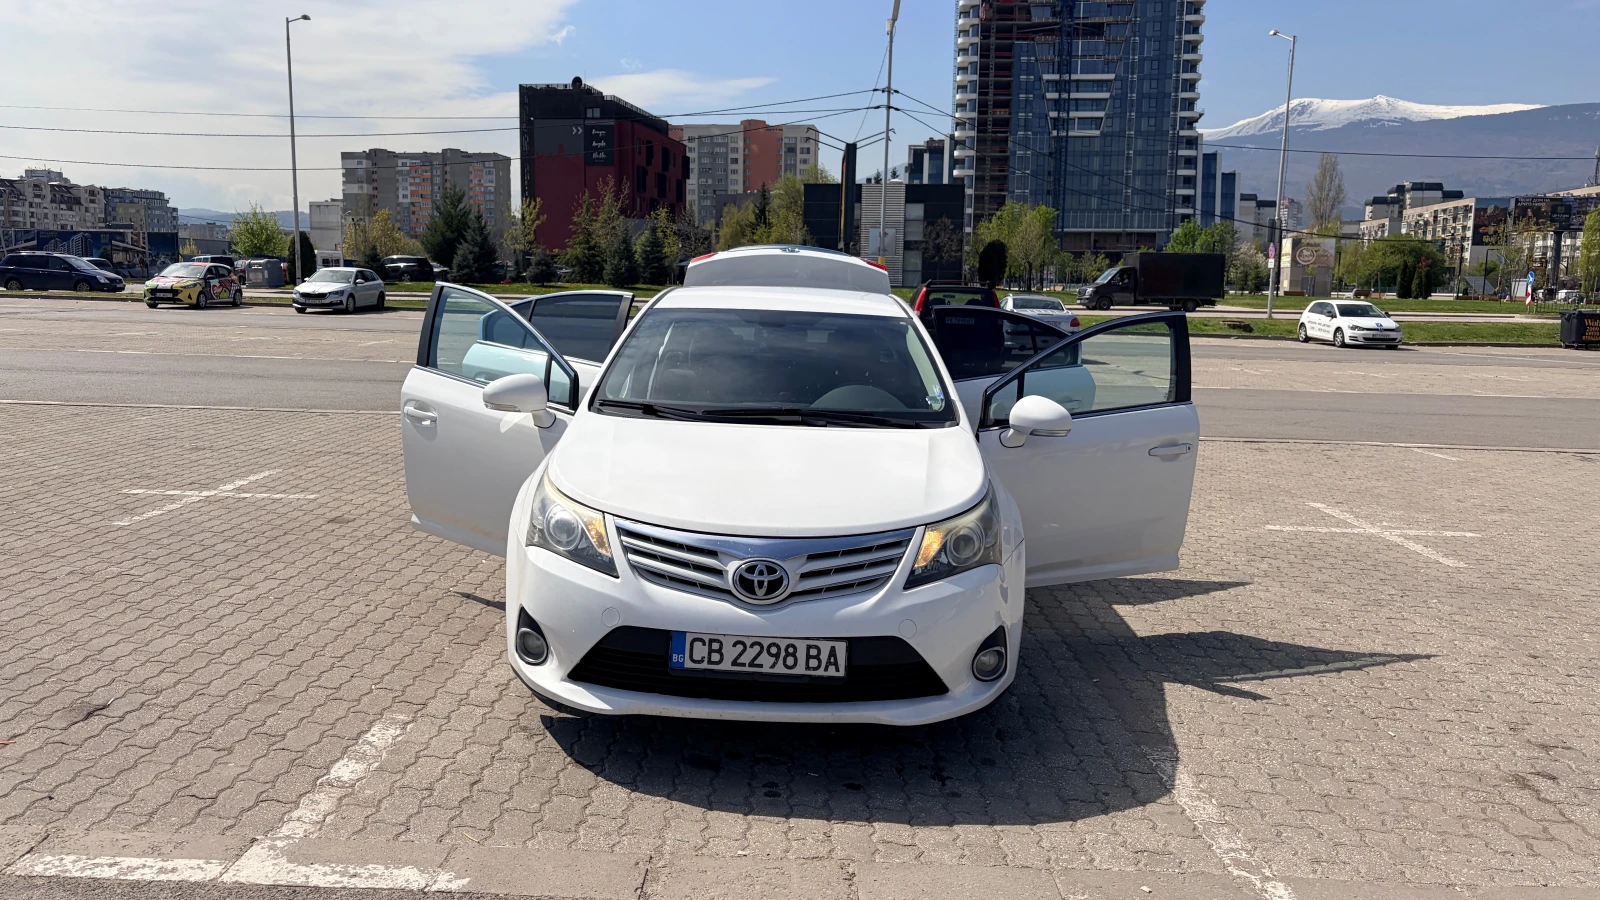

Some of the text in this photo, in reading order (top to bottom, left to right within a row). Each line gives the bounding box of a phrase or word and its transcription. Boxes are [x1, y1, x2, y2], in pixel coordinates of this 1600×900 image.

[672, 654, 684, 663] BG
[688, 637, 841, 673] CB 2298 BA
